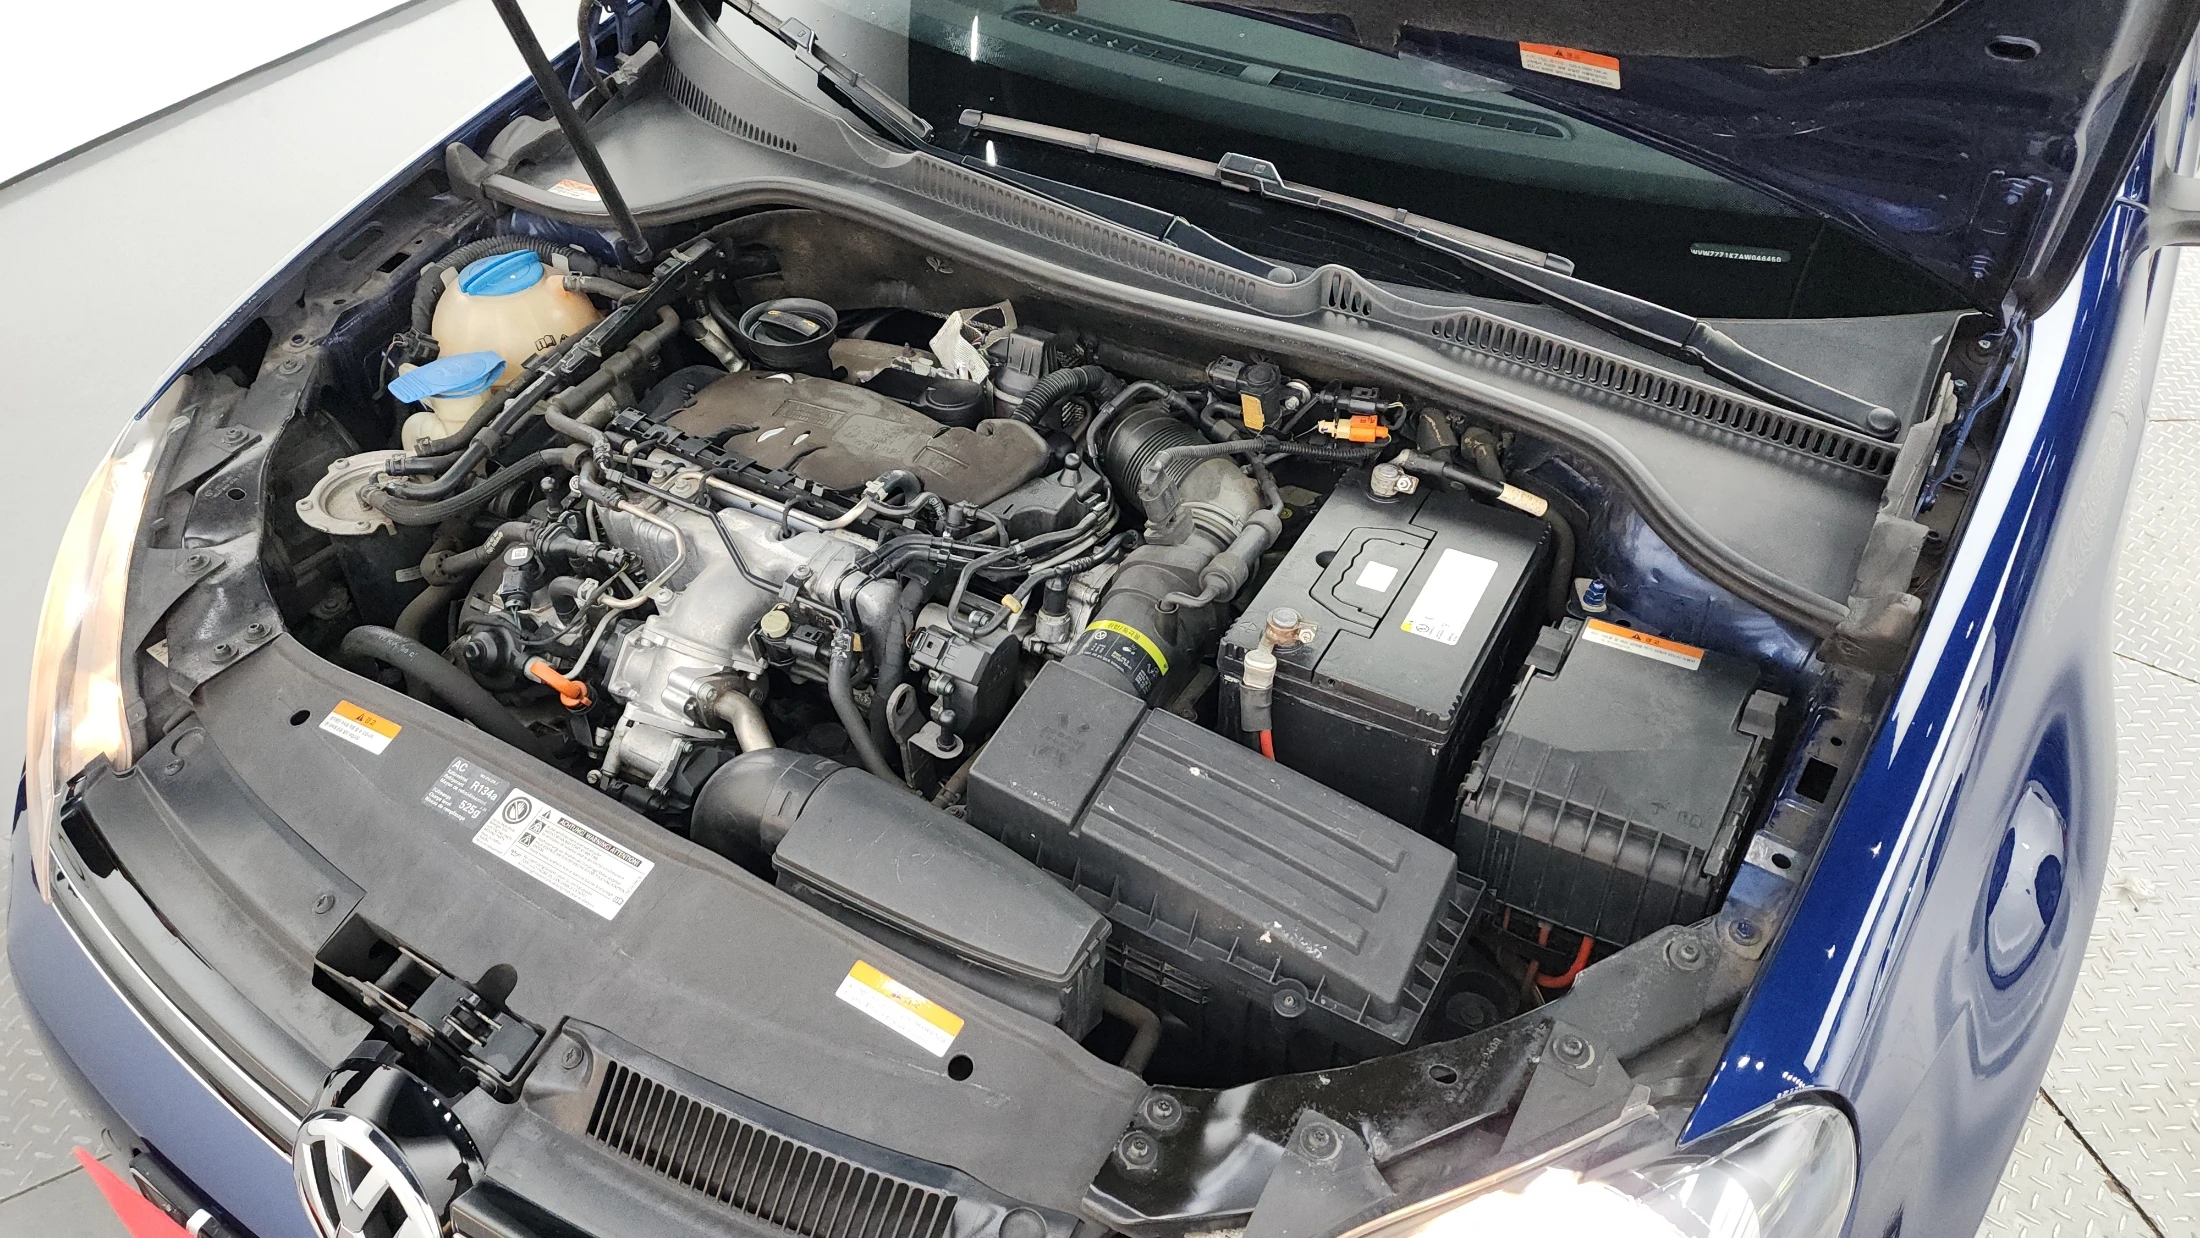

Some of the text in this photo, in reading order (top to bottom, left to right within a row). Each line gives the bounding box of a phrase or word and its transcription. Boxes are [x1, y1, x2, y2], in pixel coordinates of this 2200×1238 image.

[364, 716, 377, 726] 경고
[452, 759, 469, 772] AC
[469, 780, 498, 801] R134a
[458, 799, 481, 819] 525g
[560, 819, 587, 837] ACHTUNG!
[585, 832, 611, 850] WARNING!
[609, 847, 641, 867] ATTENTION!
